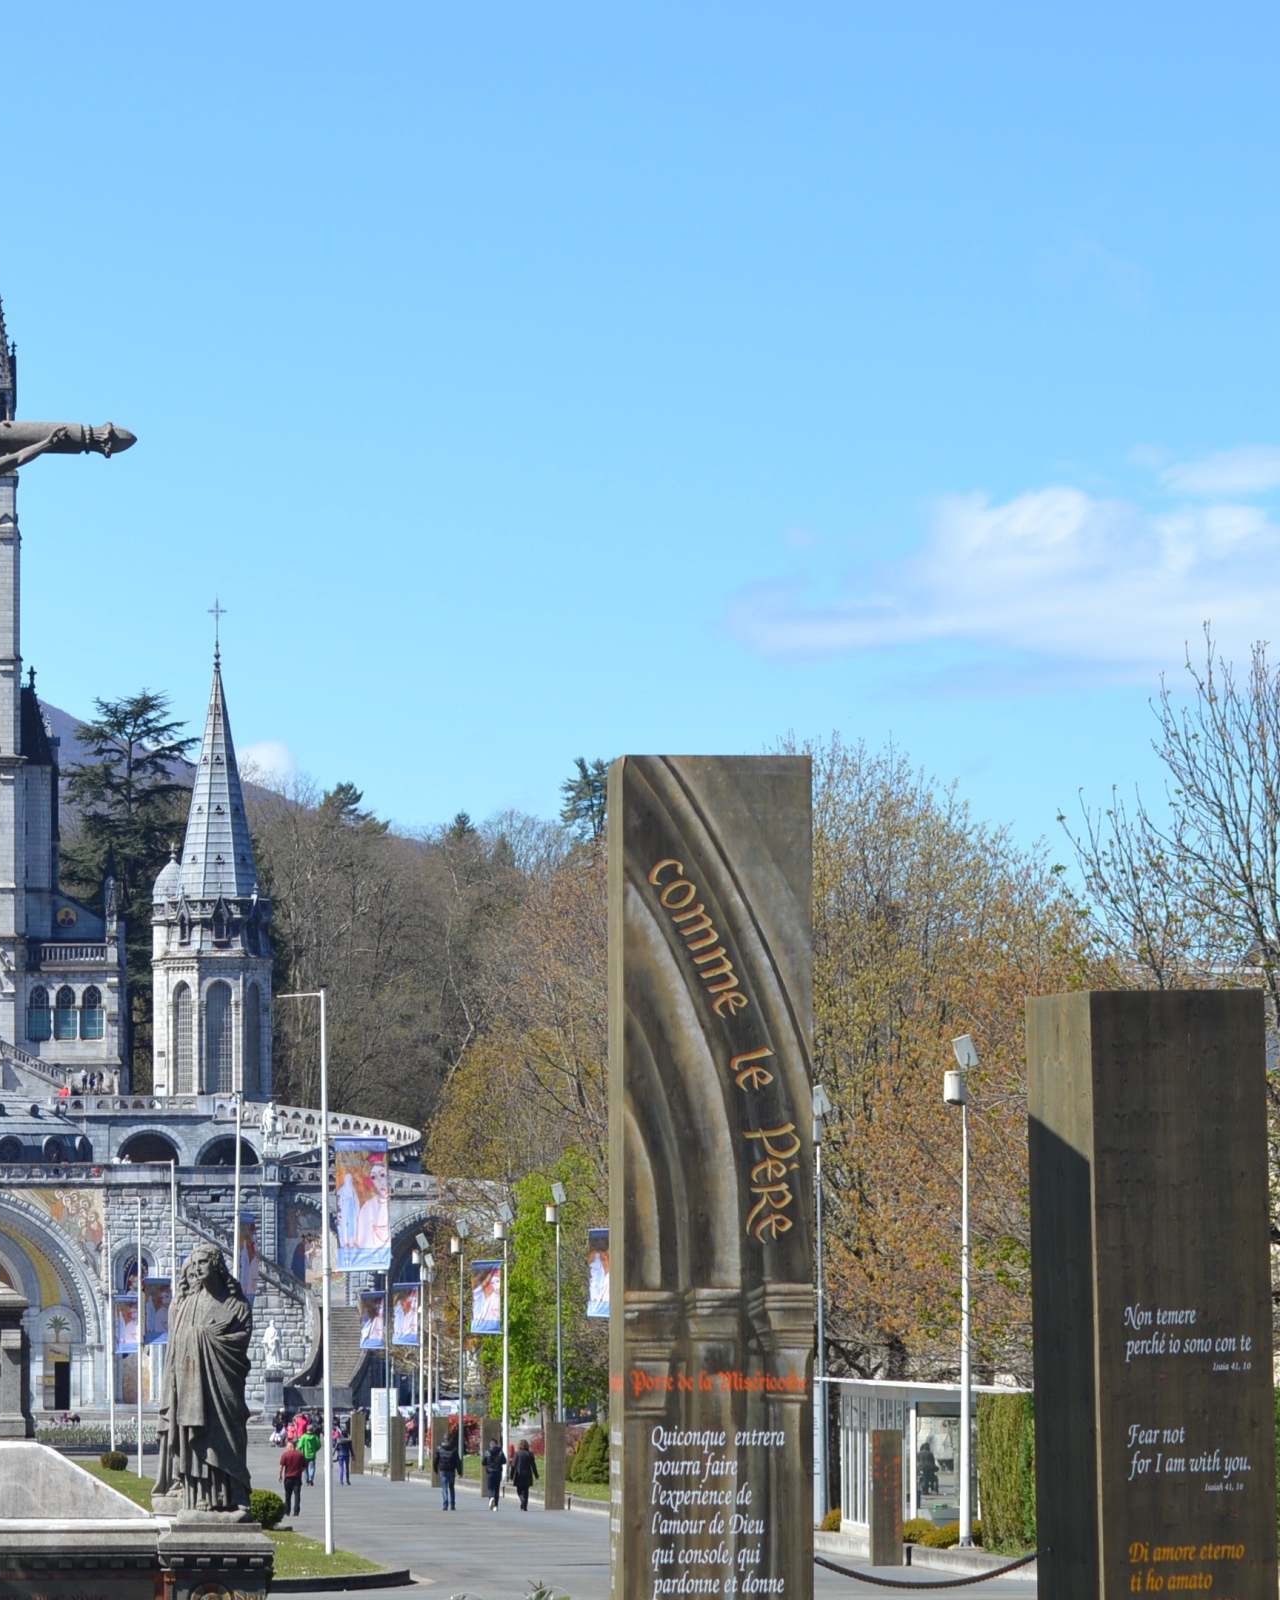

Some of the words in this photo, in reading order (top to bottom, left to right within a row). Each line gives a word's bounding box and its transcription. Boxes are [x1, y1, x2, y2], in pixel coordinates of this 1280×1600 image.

[647, 857, 749, 1019] comme
[730, 1046, 777, 1093] le
[742, 1121, 801, 1244] Père
[1124, 1303, 1153, 1330] Non
[1156, 1308, 1197, 1326] temere
[1125, 1331, 1166, 1362] perché
[1168, 1333, 1181, 1354] io
[1183, 1337, 1213, 1354] sono
[1215, 1336, 1237, 1353] con
[1240, 1334, 1253, 1352] te
[1243, 1362, 1252, 1370] 10
[630, 1369, 674, 1397] Porte
[677, 1373, 694, 1391] de
[698, 1369, 712, 1391] la
[718, 1371, 808, 1391] Miséricorde
[651, 1425, 726, 1453] Quiconque
[734, 1428, 785, 1447] entrera
[1127, 1424, 1160, 1448] Fear
[1162, 1426, 1186, 1444] not
[652, 1460, 701, 1483] pourra
[702, 1452, 738, 1483] faire
[1127, 1450, 1152, 1481] for
[1155, 1453, 1162, 1473] I
[1165, 1457, 1187, 1473] am
[1189, 1448, 1222, 1473] with
[1223, 1456, 1252, 1479] you.
[735, 1482, 752, 1505] de
[651, 1511, 706, 1535] l'amour
[708, 1511, 725, 1535] de
[729, 1513, 765, 1535] Dieu
[651, 1543, 675, 1572] qui
[678, 1541, 734, 1566] console,
[737, 1543, 761, 1571] qui
[1128, 1541, 1150, 1563] Di
[1152, 1545, 1197, 1562] amore
[1200, 1543, 1246, 1560] eterno
[653, 1571, 720, 1600] pardonne
[723, 1577, 738, 1594] et
[741, 1571, 785, 1594] donne
[1129, 1570, 1143, 1592] ti
[1145, 1567, 1164, 1591] ho
[1167, 1572, 1213, 1590] amato
